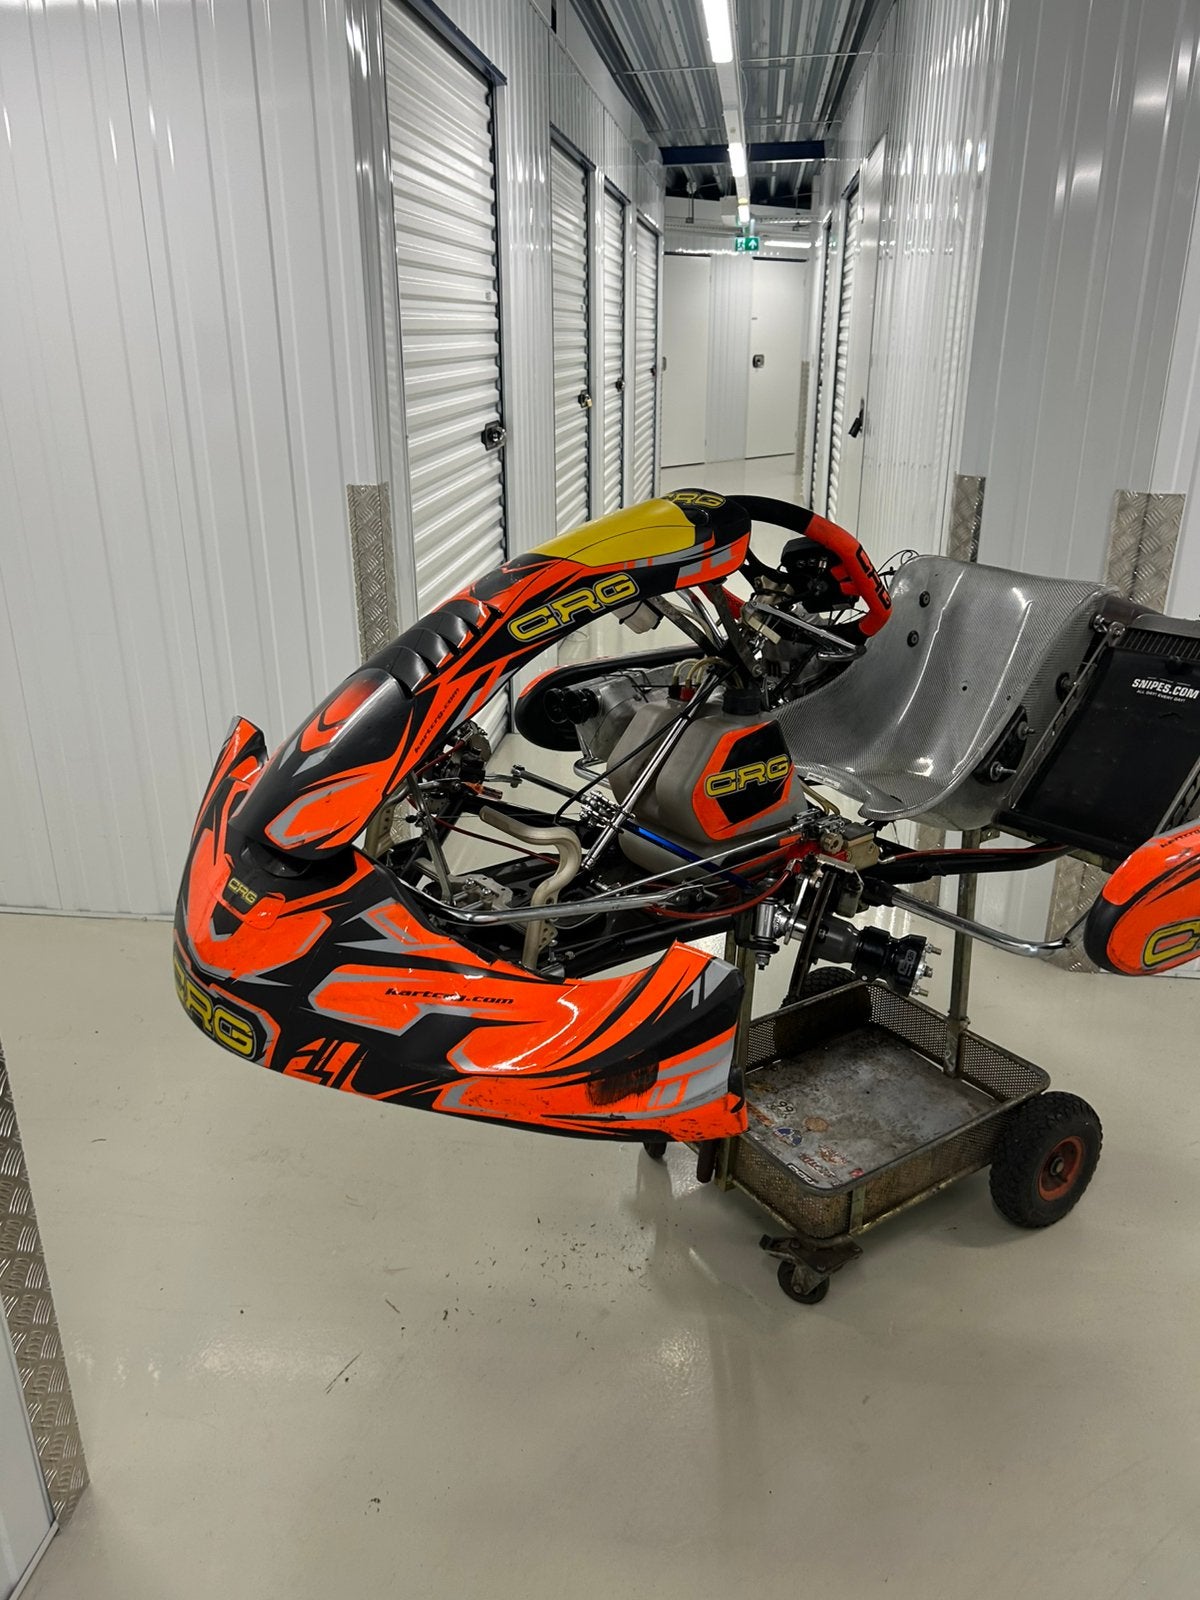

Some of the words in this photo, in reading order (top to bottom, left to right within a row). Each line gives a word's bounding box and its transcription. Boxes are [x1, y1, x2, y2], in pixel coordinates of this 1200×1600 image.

[507, 572, 640, 642] CRG
[1131, 678, 1200, 699] SNIPES.COM
[704, 753, 791, 798] CRG
[228, 877, 258, 905] CRG
